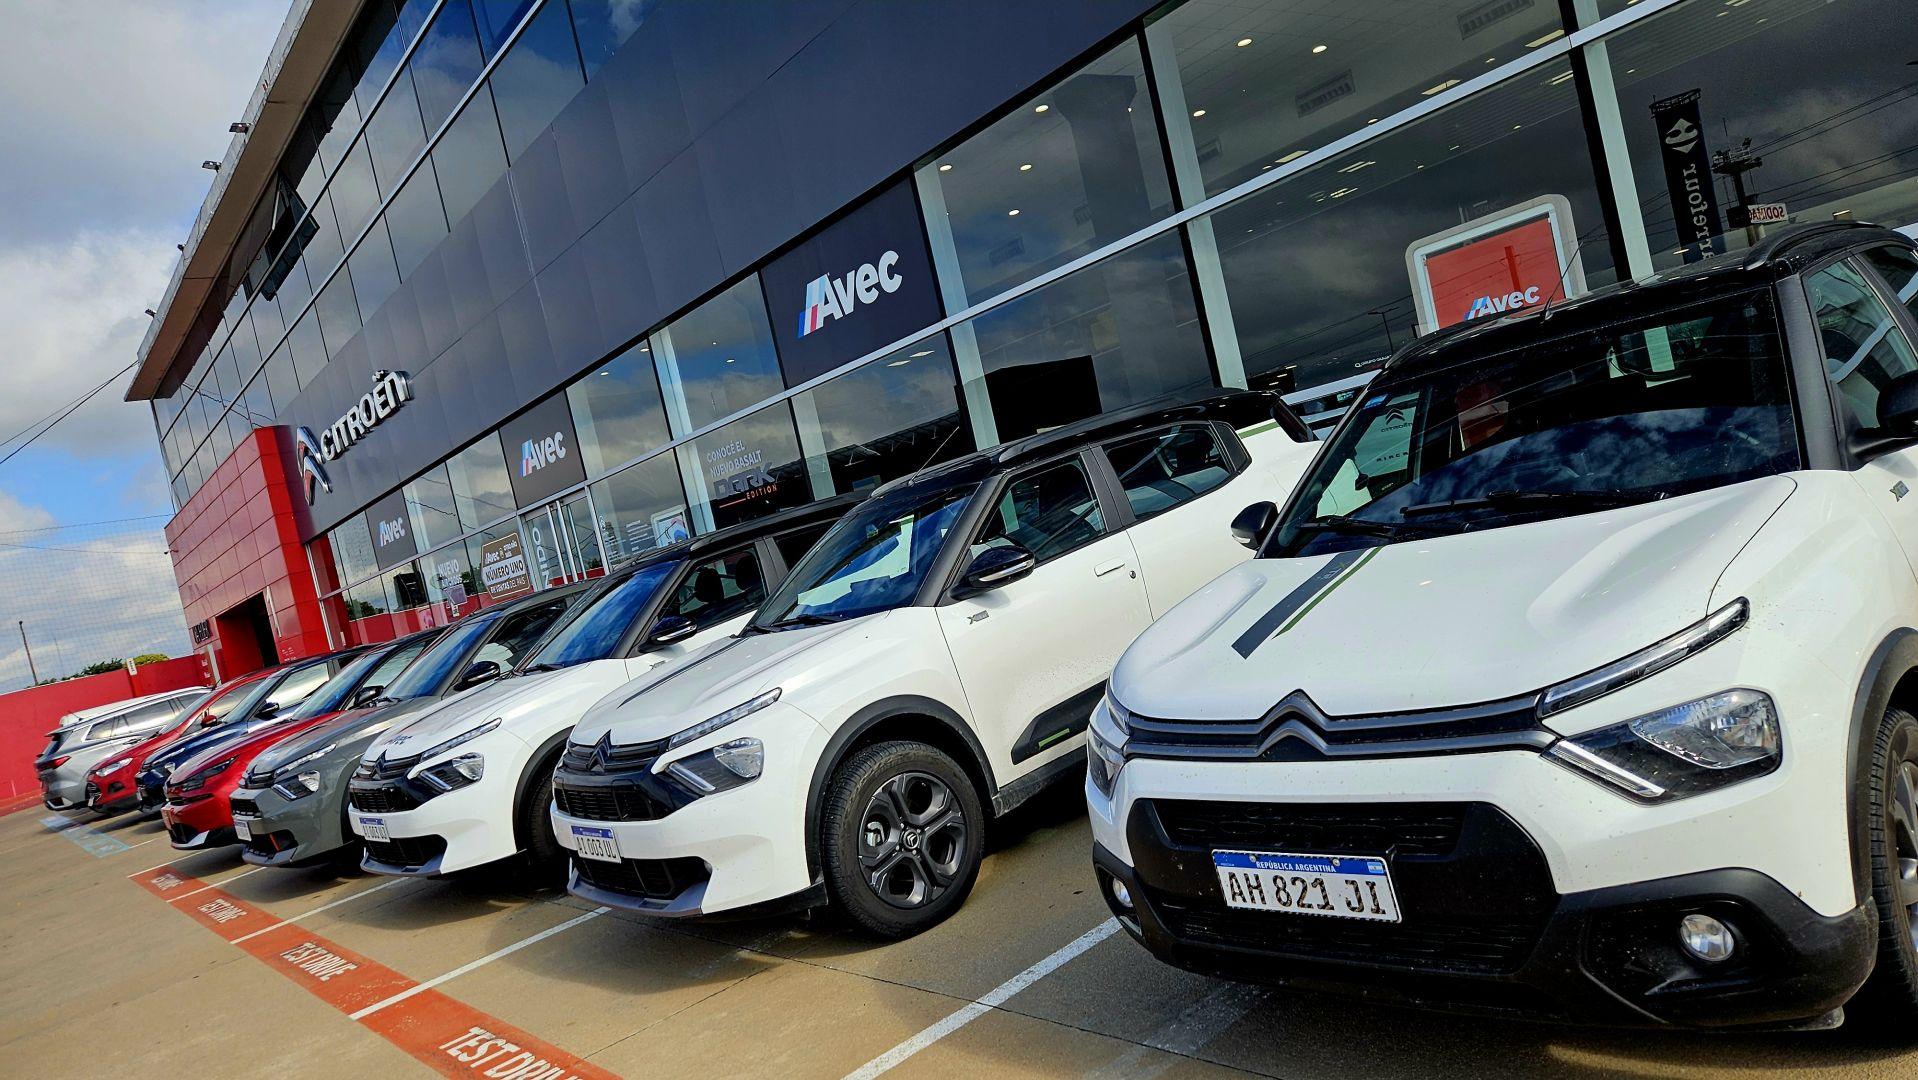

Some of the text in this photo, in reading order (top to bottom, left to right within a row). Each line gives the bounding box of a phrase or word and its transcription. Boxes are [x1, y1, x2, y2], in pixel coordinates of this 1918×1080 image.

[800, 250, 903, 337] Avec
[1466, 286, 1540, 320] Avec
[522, 431, 566, 476] Avec
[710, 450, 762, 478] NUEVO BASALT
[746, 484, 778, 500] EDITION
[380, 516, 406, 547] Avec
[509, 560, 524, 574] UNO
[1256, 860, 1337, 873] REPÚBLICA ARGENTINA
[1228, 872, 1386, 915] AH 821 JI
[280, 943, 328, 964] TEST
[438, 1026, 521, 1068] TEST
